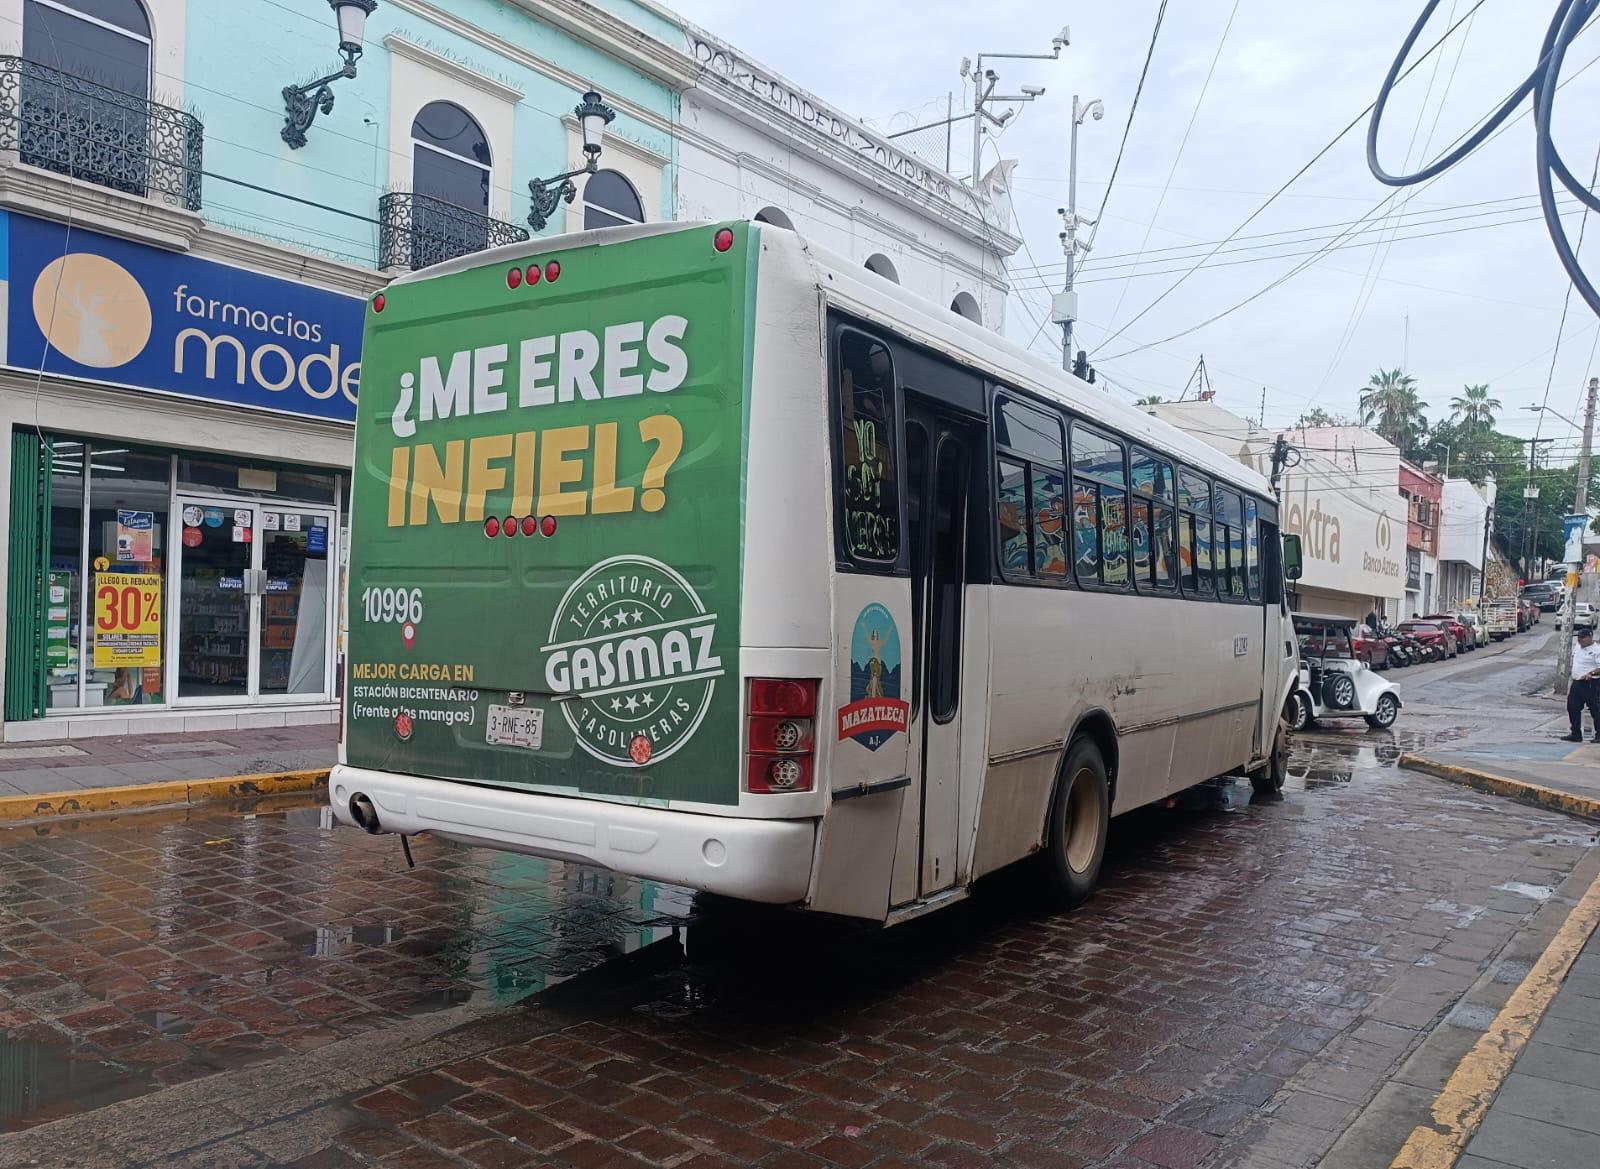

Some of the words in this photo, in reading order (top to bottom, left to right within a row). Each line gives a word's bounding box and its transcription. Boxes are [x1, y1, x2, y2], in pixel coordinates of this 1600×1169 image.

[174, 284, 322, 342] farmacias
[391, 343, 508, 437] ¿ME
[519, 315, 689, 408] ERES
[854, 419, 876, 462] YO
[387, 415, 684, 527] INFIEL?
[1363, 551, 1382, 571] Banco
[1382, 556, 1399, 577] Azteca
[121, 577, 129, 585] EL
[361, 586, 423, 624] 10996
[570, 576, 673, 628] TERRITORIO
[353, 663, 397, 679] MEJOR
[399, 663, 451, 680] CARGA
[454, 665, 474, 681] EN
[545, 624, 722, 693] GASMAZ
[353, 683, 398, 698] ESTACIÓN
[400, 686, 479, 701] BICENTENARIO
[353, 701, 390, 719] (Frente
[419, 706, 475, 725] mangos)
[491, 716, 538, 735] 3-RNE-85
[842, 706, 905, 731] MAZATLECA
